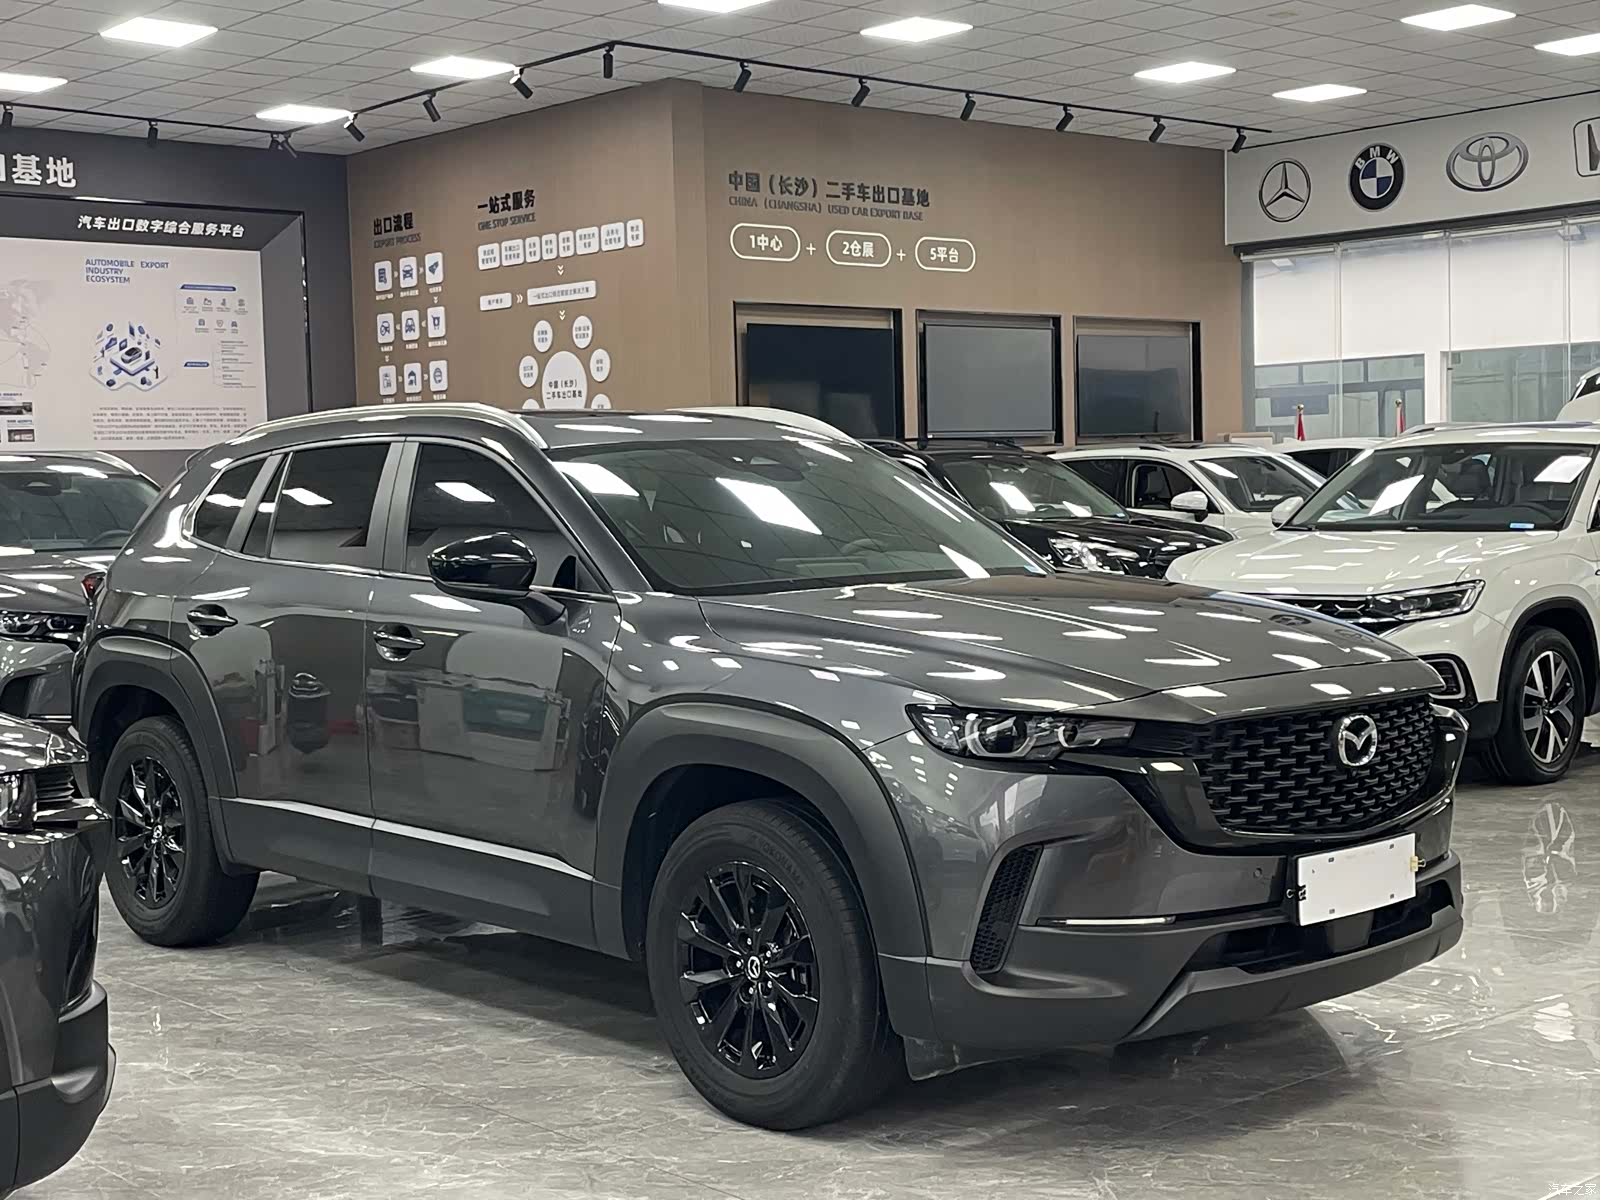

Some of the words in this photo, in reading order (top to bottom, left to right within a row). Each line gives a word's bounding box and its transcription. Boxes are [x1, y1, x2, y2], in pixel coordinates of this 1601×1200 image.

[1355, 146, 1399, 170] BMW
[0, 153, 77, 188] 基地
[477, 188, 536, 214] 一站式服务
[77, 215, 245, 238] 汽车出口数字综合服务平台
[373, 211, 414, 236] 出口流程
[748, 233, 784, 253] 1中心
[841, 239, 875, 259] 2仓展
[85, 258, 135, 268] AUTOMOBILE
[140, 260, 170, 269] EXPORT
[929, 246, 960, 264] 5平台
[85, 267, 124, 275] INDUSTRY
[85, 275, 130, 283] ECOSYSTEM
